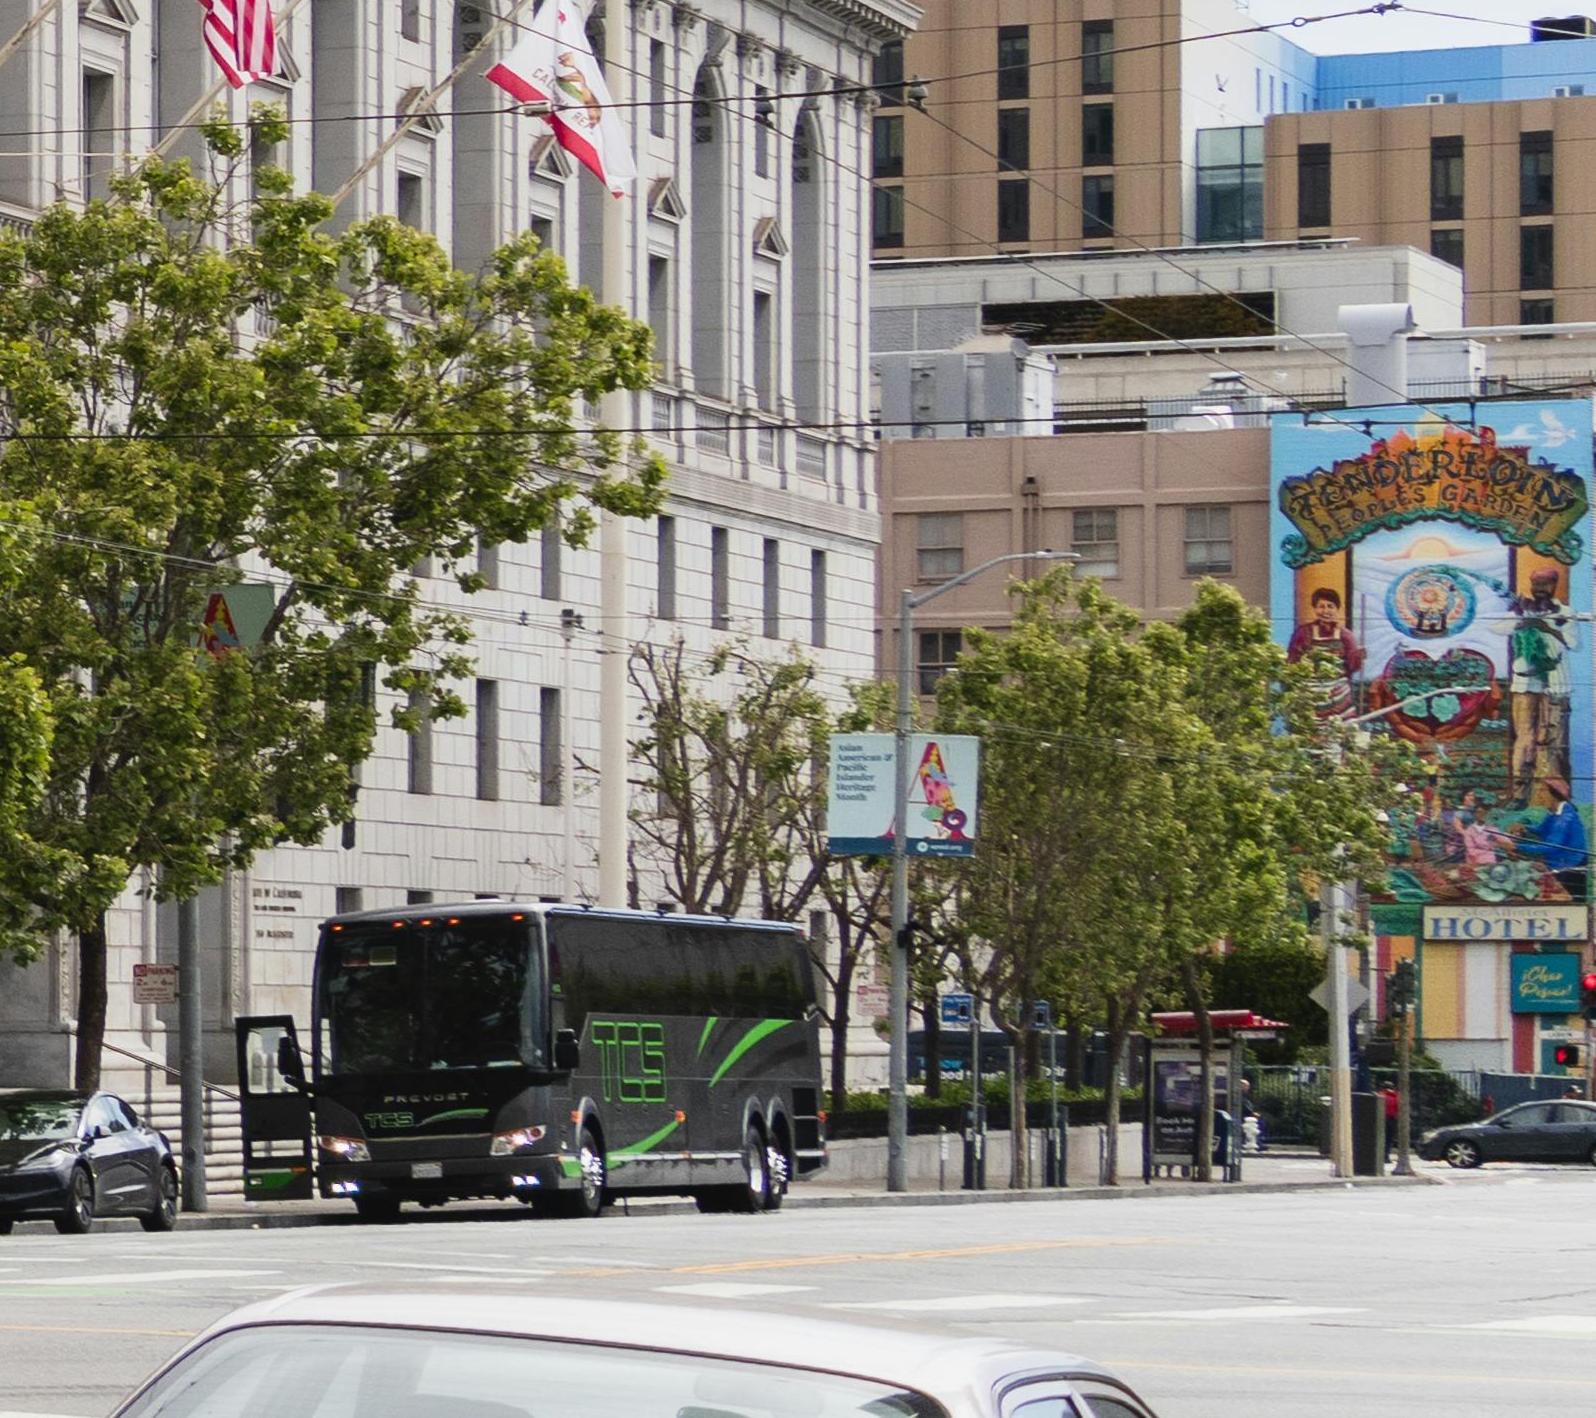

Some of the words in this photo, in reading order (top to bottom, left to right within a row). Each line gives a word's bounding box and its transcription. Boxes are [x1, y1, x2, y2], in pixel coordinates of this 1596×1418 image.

[1290, 445, 1576, 520] TENDERLOIN
[1442, 483, 1554, 532] GARDEN
[837, 743, 863, 752] Asian
[838, 753, 882, 762] American
[837, 763, 868, 772] Pacific
[1430, 917, 1583, 940] HOTEL
[592, 1021, 667, 1102] TCS
[383, 1092, 470, 1103] PREVOST
[364, 1112, 414, 1129] TCS
